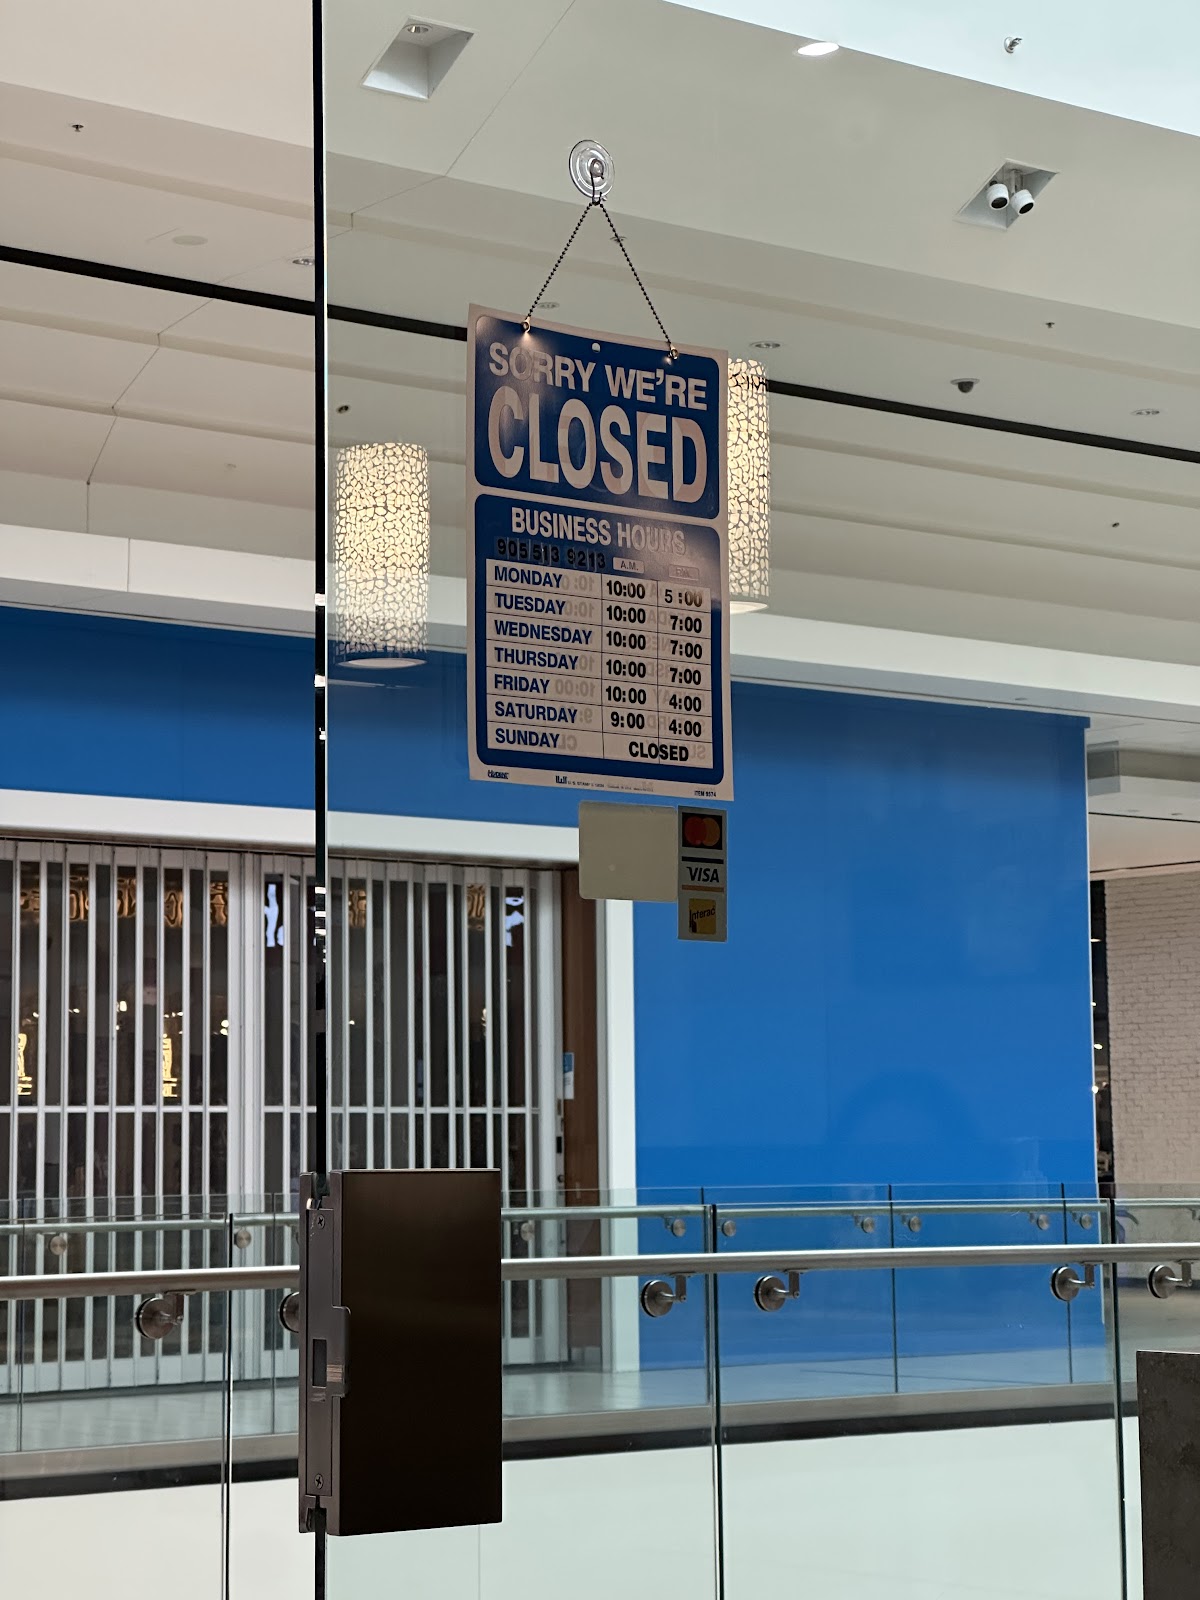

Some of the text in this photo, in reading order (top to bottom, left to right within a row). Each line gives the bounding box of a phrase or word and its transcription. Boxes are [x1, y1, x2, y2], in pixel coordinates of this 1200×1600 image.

[489, 342, 708, 411] SORRY WE'RE
[488, 386, 708, 503] CLOSED
[511, 507, 686, 555] BUSINESS HOURS
[497, 539, 606, 568] 905 513 9213
[620, 560, 639, 571] A.M.
[494, 565, 563, 588] MONDAY
[606, 580, 646, 599] 10:00
[495, 592, 566, 615] TUESDAY
[606, 605, 646, 624] 10:00
[670, 615, 703, 633] 7:00
[494, 619, 593, 645] WEDNESDAY
[606, 631, 646, 650] 10:00
[670, 640, 703, 659] 7:00
[494, 647, 579, 670] THURSDAY
[606, 660, 646, 679] 10:00
[669, 667, 702, 685] 7:00
[494, 674, 550, 694] FRIDAY
[605, 686, 647, 705] 10:00
[669, 694, 702, 712] 4:00
[495, 701, 578, 724] SATURDAY
[610, 711, 645, 730] 9:00
[669, 720, 702, 738] 4:00
[495, 728, 560, 749] SUNDAY
[628, 741, 689, 762] CLOSED
[686, 866, 720, 883] VISA
[689, 905, 716, 923] Interac
